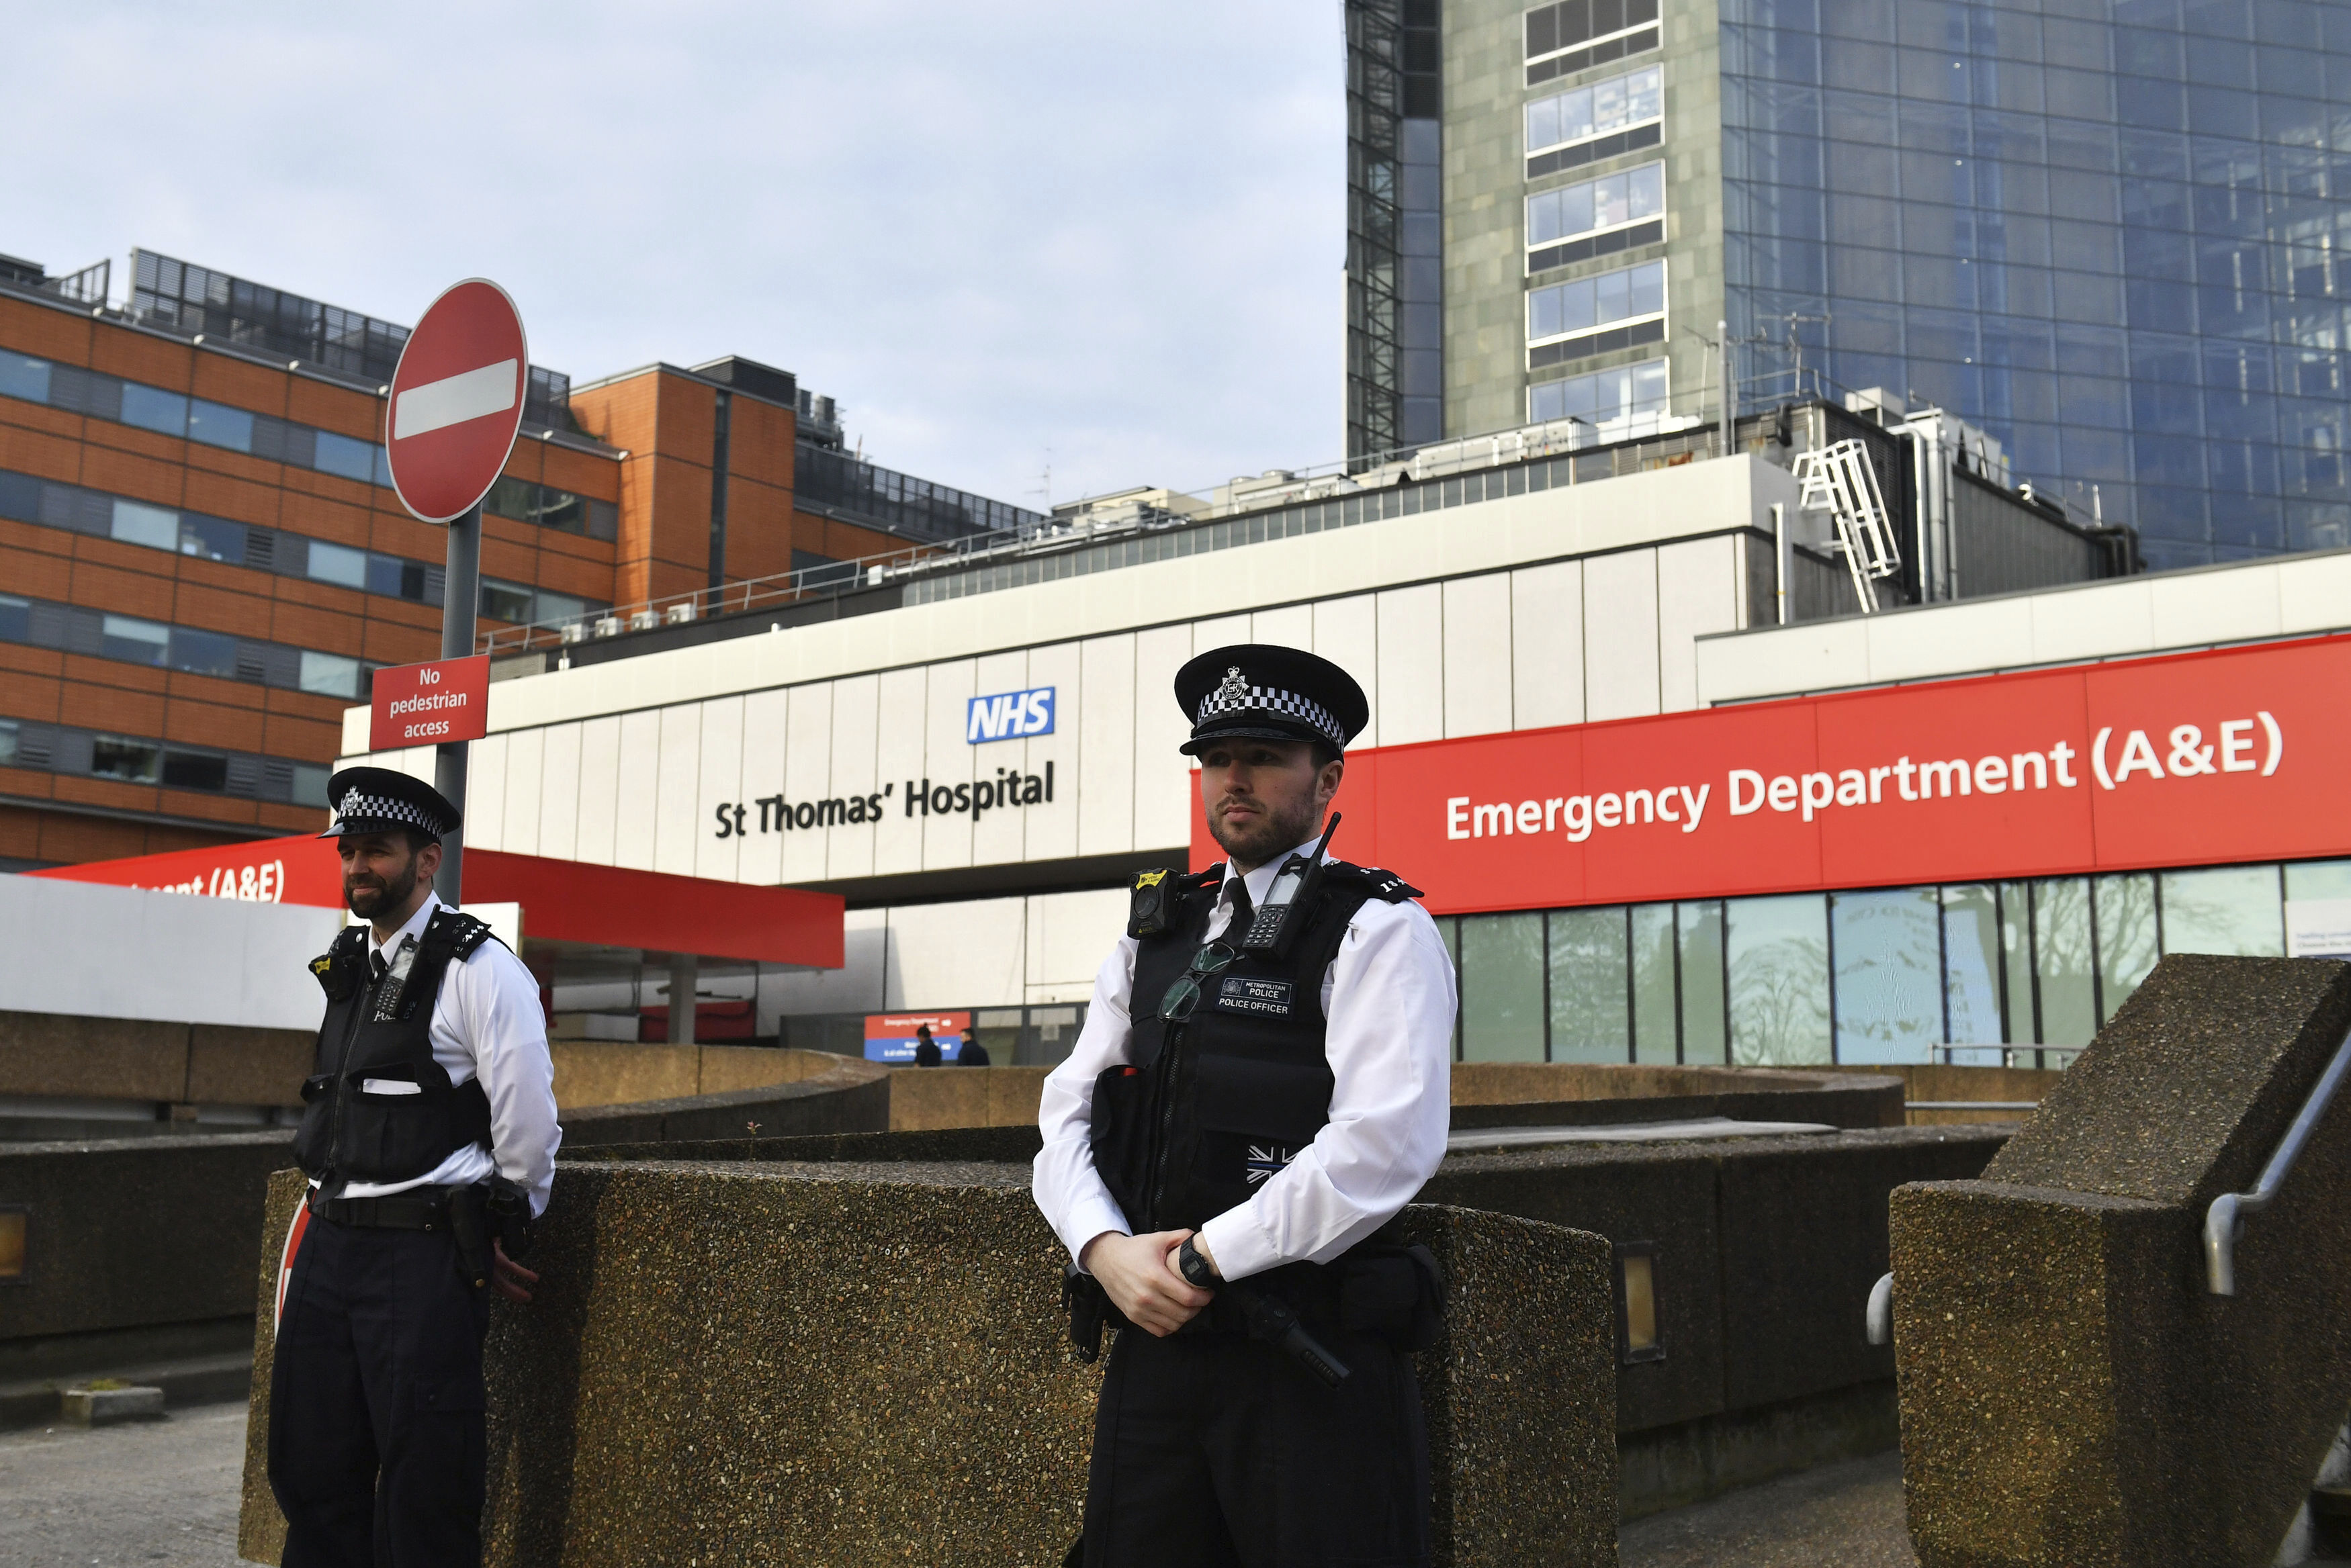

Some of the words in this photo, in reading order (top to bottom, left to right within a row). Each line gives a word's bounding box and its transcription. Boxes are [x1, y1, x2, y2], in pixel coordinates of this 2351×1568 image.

[419, 667, 441, 686] No
[390, 690, 467, 719] pedestrian
[968, 688, 1049, 740] NHS
[404, 721, 449, 738] access
[1446, 782, 1711, 843] Emergency
[1728, 740, 2078, 823] Department
[2091, 710, 2283, 791] (A&E)
[715, 802, 747, 840] St
[905, 760, 1055, 822] Hospital
[1245, 982, 1286, 991] METROPOLITAN
[1249, 988, 1279, 999] POLICE
[1218, 998, 1249, 1009] POLICE
[1250, 1001, 1288, 1015] OFFICER
